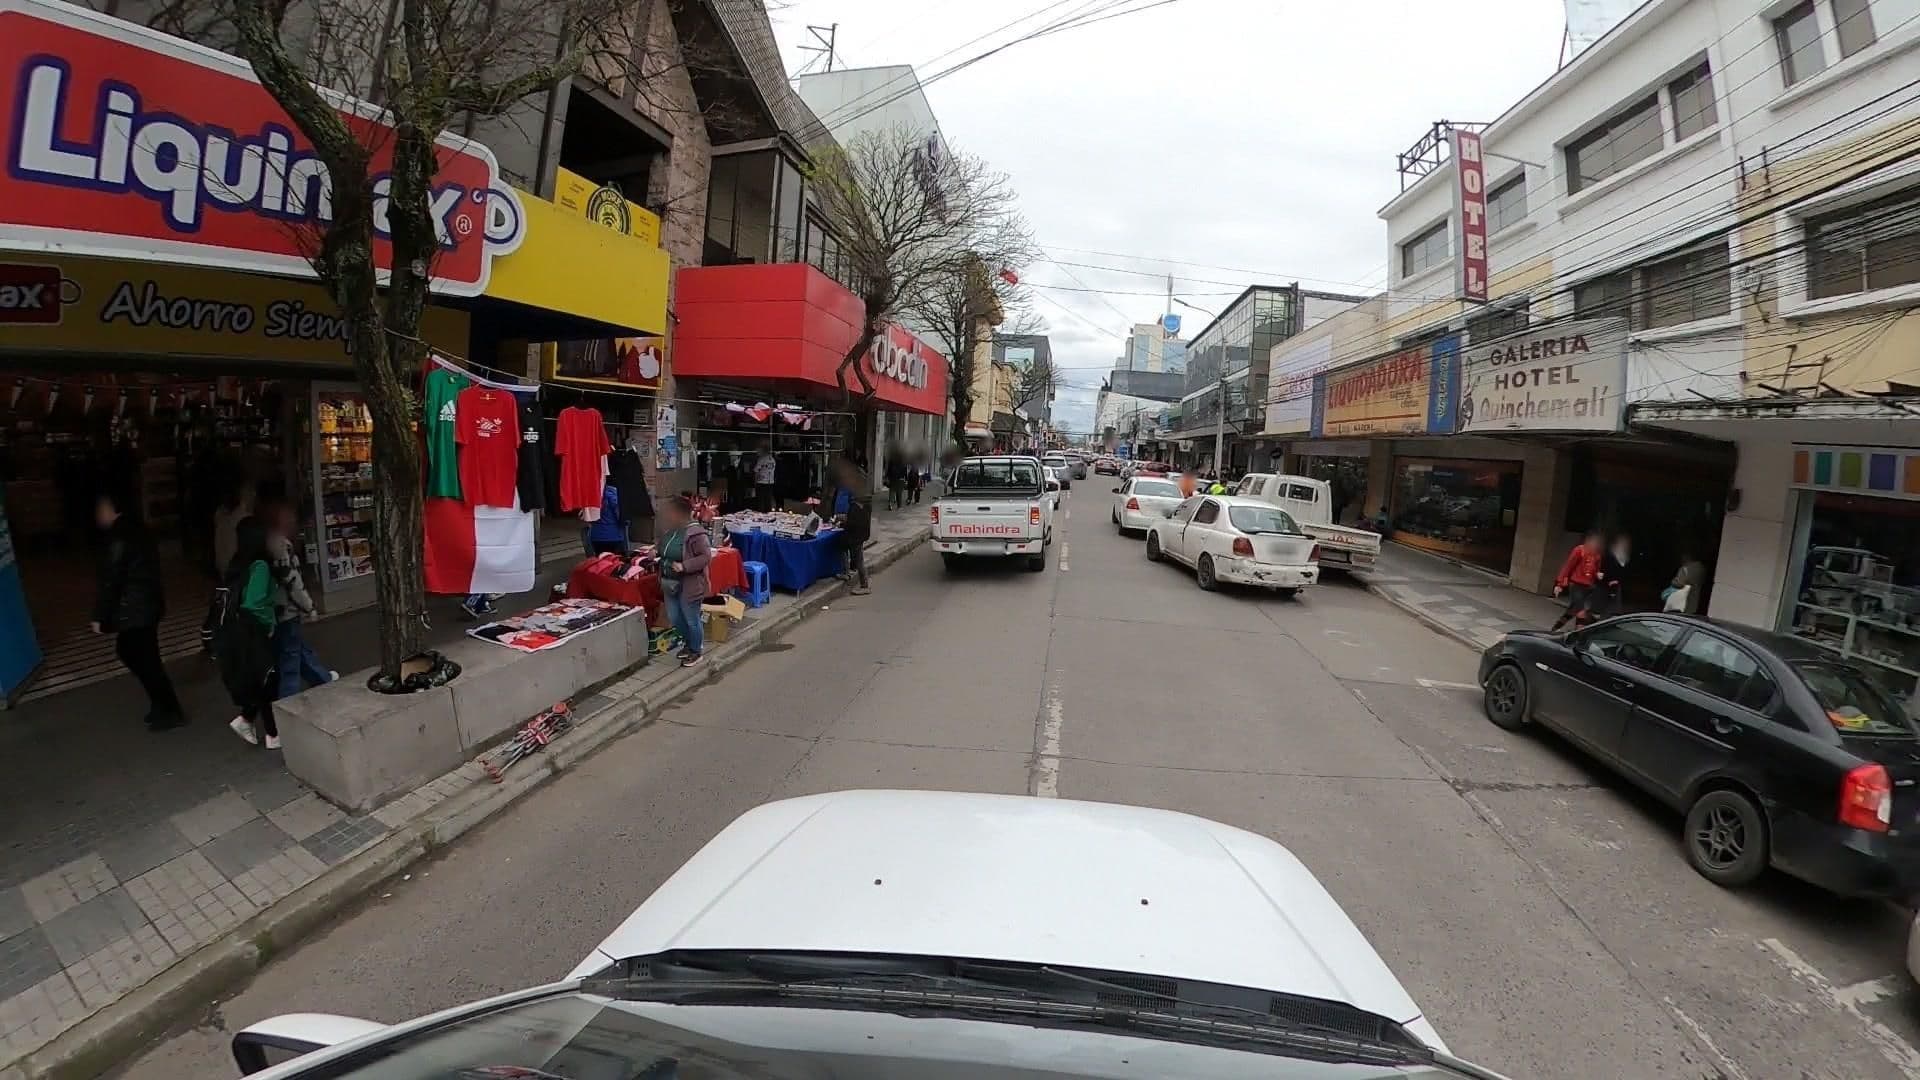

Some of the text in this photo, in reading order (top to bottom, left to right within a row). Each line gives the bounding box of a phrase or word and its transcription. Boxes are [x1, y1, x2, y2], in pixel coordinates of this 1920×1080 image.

[1460, 136, 1485, 295] HOTEL
[103, 281, 253, 332] Ahorro
[870, 326, 928, 390] abcdin
[1490, 334, 1590, 366] GALERIA
[1494, 365, 1581, 391] HOTEL
[949, 524, 1021, 535] Mahindra
